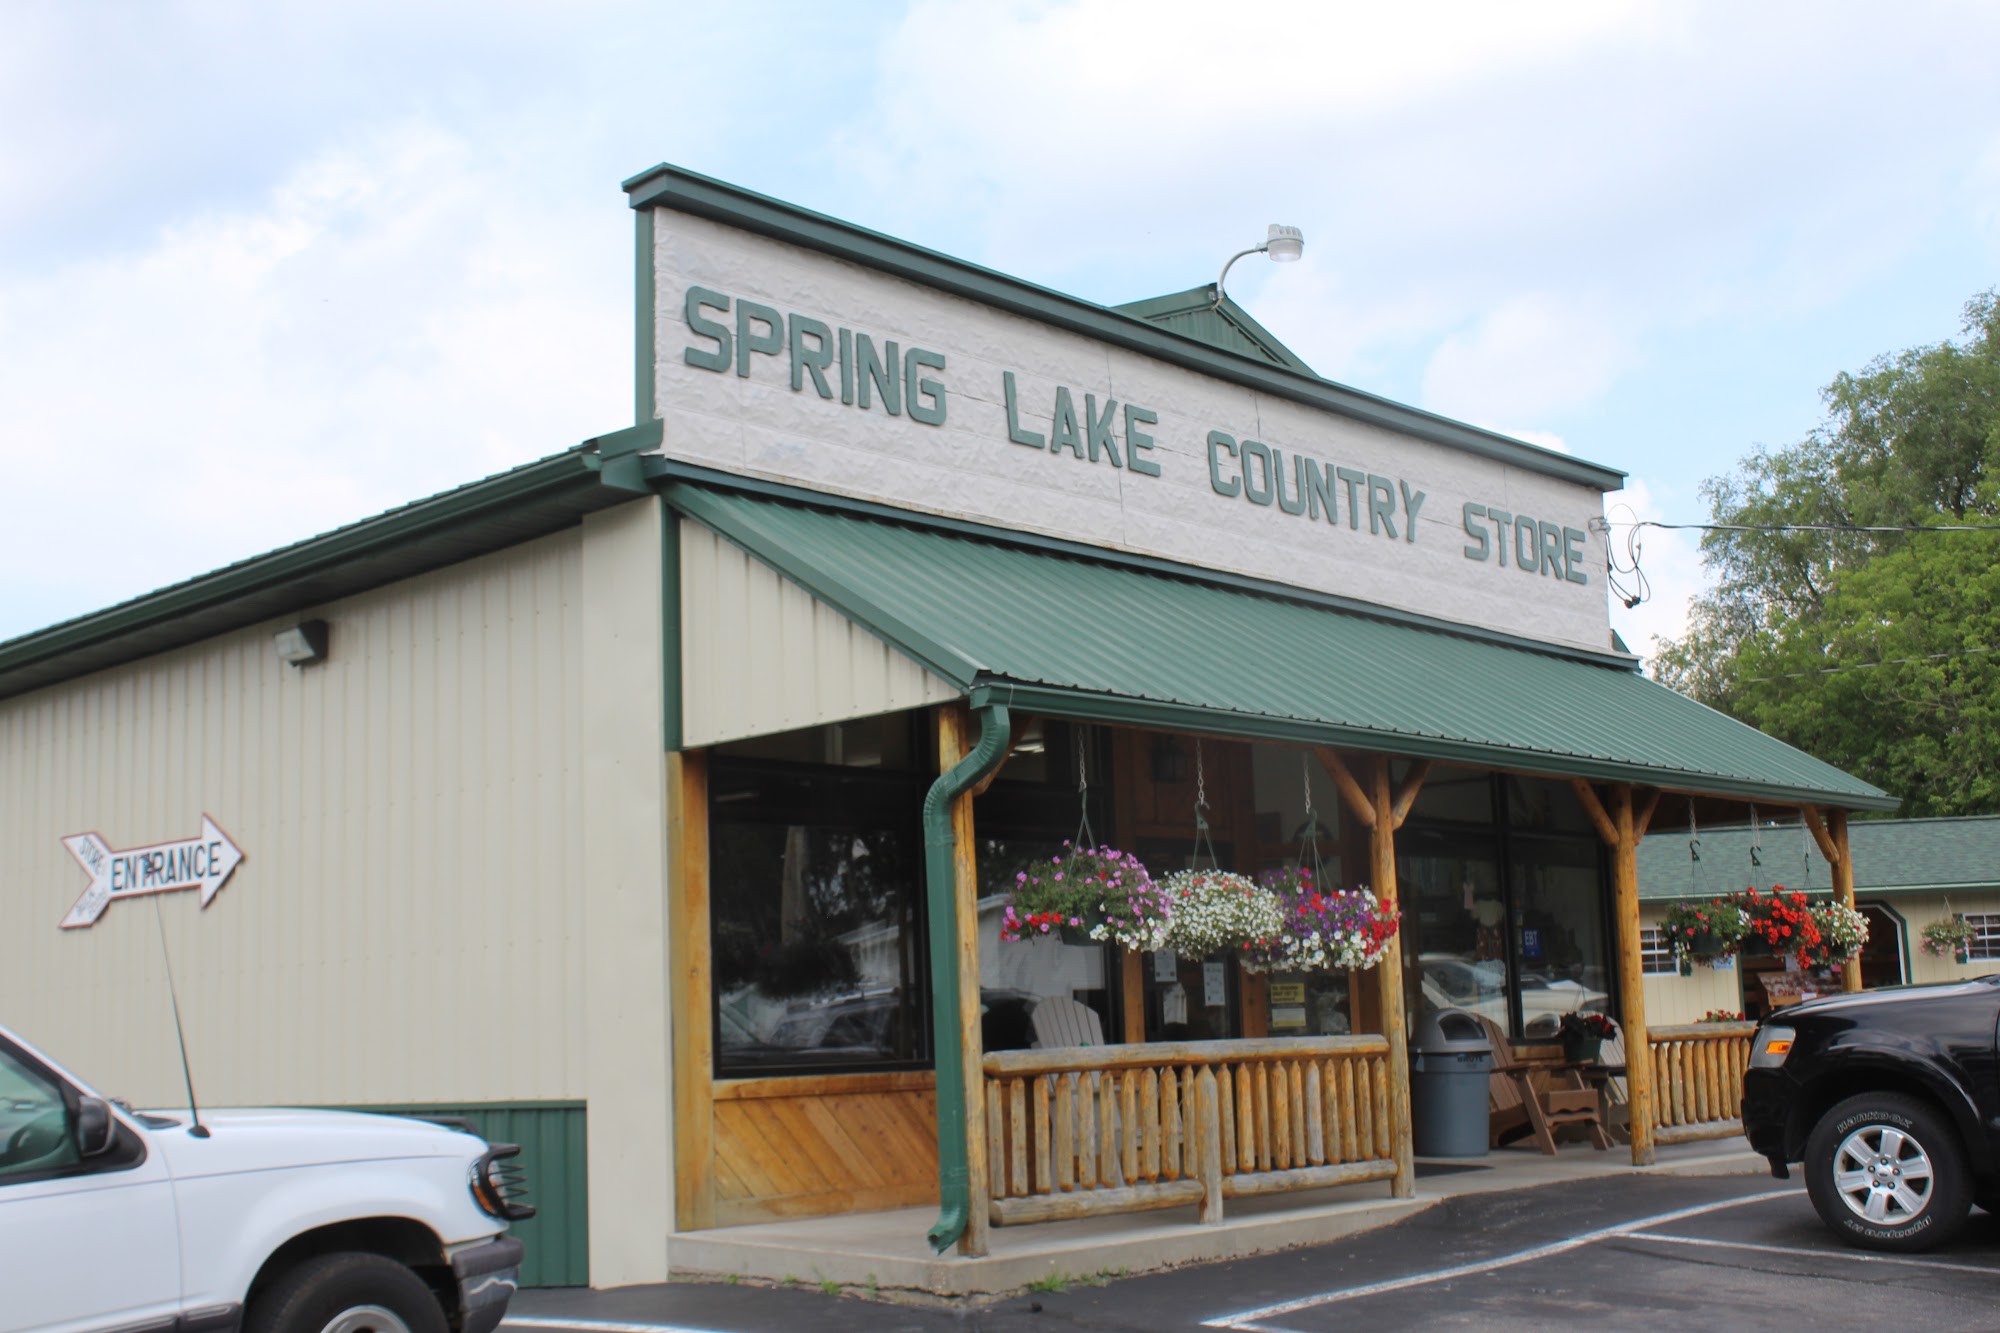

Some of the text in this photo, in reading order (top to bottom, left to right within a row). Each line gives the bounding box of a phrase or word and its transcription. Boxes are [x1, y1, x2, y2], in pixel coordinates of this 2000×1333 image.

[685, 286, 1587, 585] SPRING LAKE COUNTRY STORE
[111, 841, 222, 891] ENTRANCE
[1524, 930, 1538, 946] EBT
